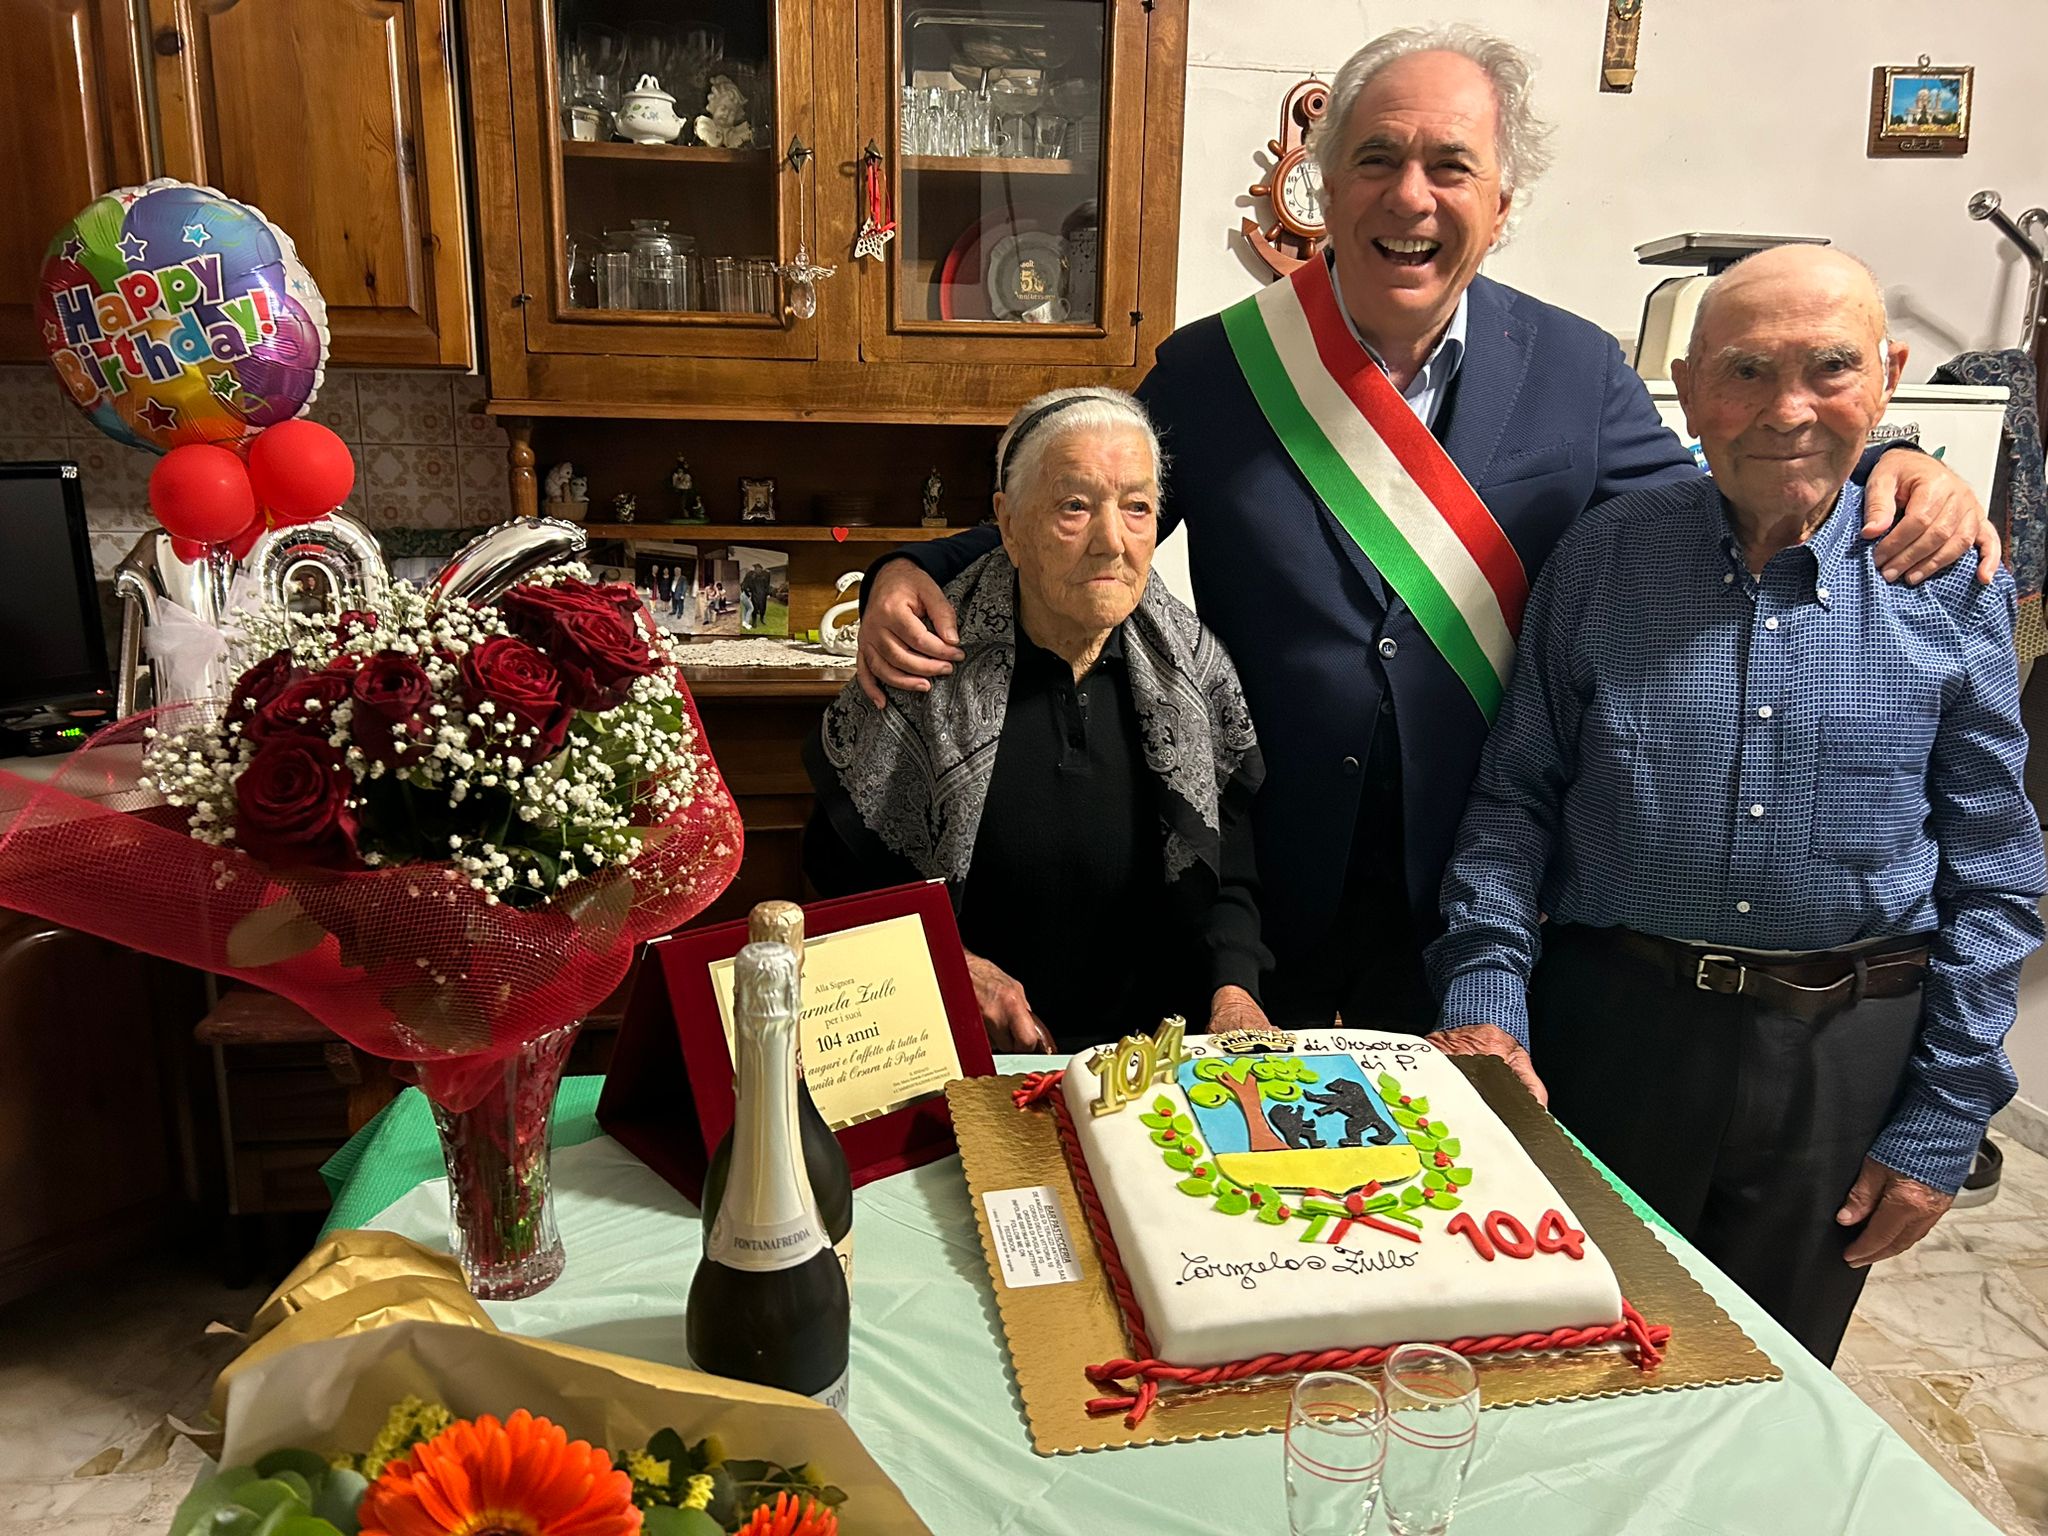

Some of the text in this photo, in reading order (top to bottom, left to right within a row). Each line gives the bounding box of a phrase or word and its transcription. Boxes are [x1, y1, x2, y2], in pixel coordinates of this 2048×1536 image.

[1297, 209, 1304, 217] 7
[1307, 210, 1315, 219] 6
[54, 253, 224, 346] Happy
[52, 287, 278, 407] Birthday!
[799, 977, 896, 1020] armela Zullo
[815, 978, 855, 994] Alla Signora
[825, 1017, 838, 1029] per
[845, 1008, 862, 1020] suoi
[816, 1021, 880, 1053] 104 anni
[842, 1057, 849, 1066] e
[886, 1039, 896, 1051] di
[897, 1034, 918, 1049] tutta
[920, 1028, 930, 1041] la
[808, 1075, 835, 1093] unità
[836, 1071, 848, 1085] di
[849, 1064, 881, 1081] Orsara
[882, 1058, 893, 1070] di
[894, 1046, 927, 1066] Puglia
[1089, 1014, 1193, 1119] 104
[733, 1228, 811, 1248] FONTANAFREDDA
[1023, 1209, 1033, 1229] ORSARA
[1032, 1236, 1041, 1254] PUGLIA
[1029, 1204, 1039, 1221] CORSO
[1035, 1222, 1044, 1238] DELLA
[1046, 1205, 1071, 1263] BAR PASTICCERIA
[1447, 1209, 1585, 1261] 104
[1016, 1240, 1023, 1248] ME
[1019, 1248, 1026, 1256] ON
